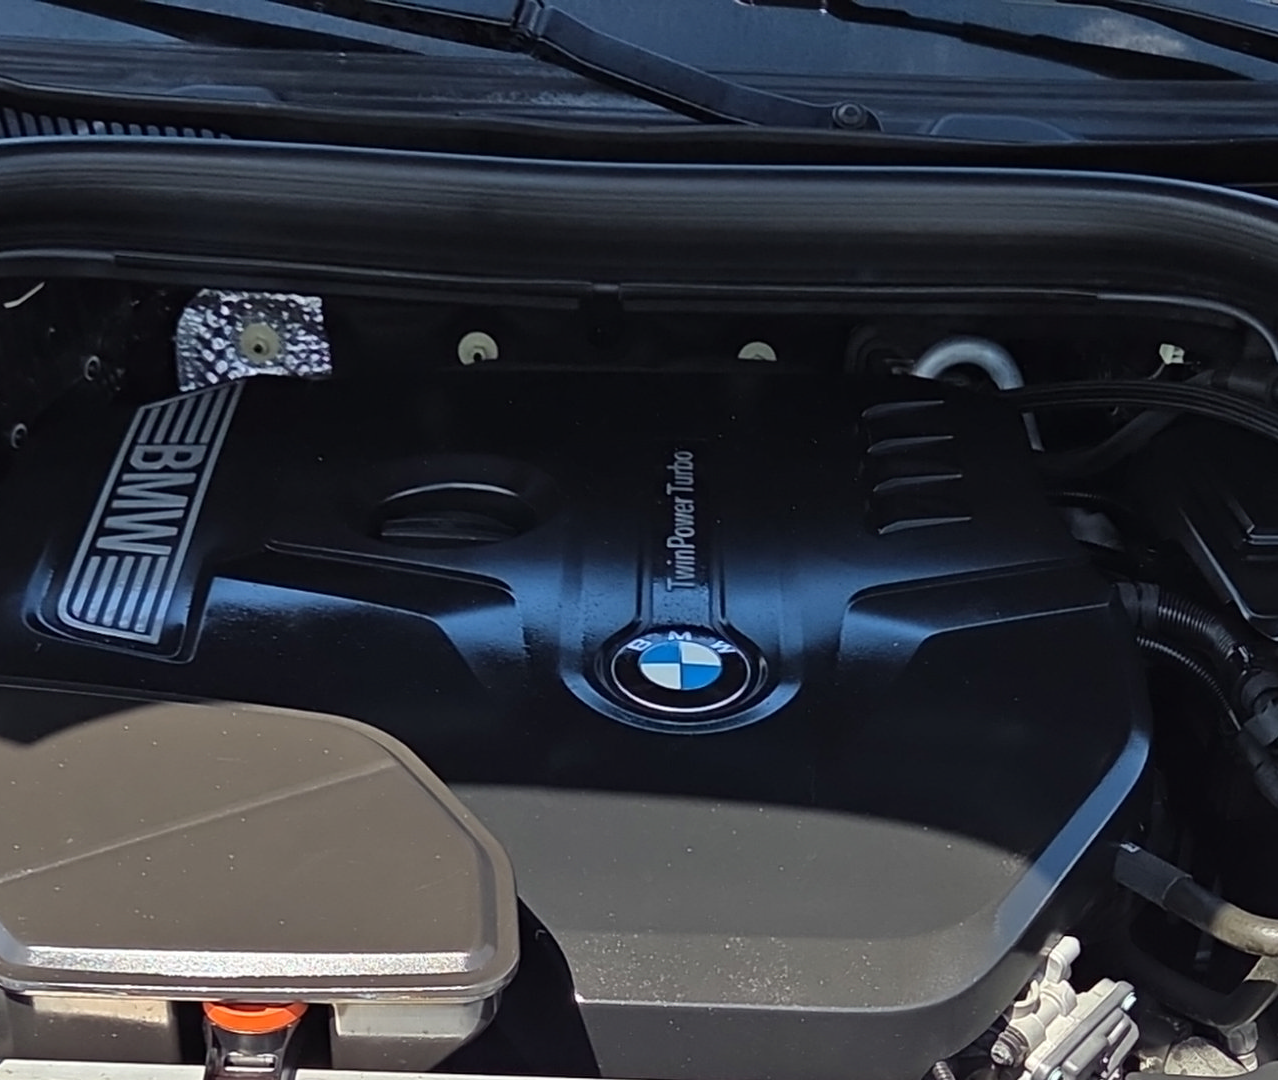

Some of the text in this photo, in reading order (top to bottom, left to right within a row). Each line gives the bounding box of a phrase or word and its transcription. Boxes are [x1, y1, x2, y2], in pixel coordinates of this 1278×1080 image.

[96, 444, 208, 556] BMW
[666, 450, 696, 592] TwinPower Turbo
[625, 630, 739, 654] BMW
